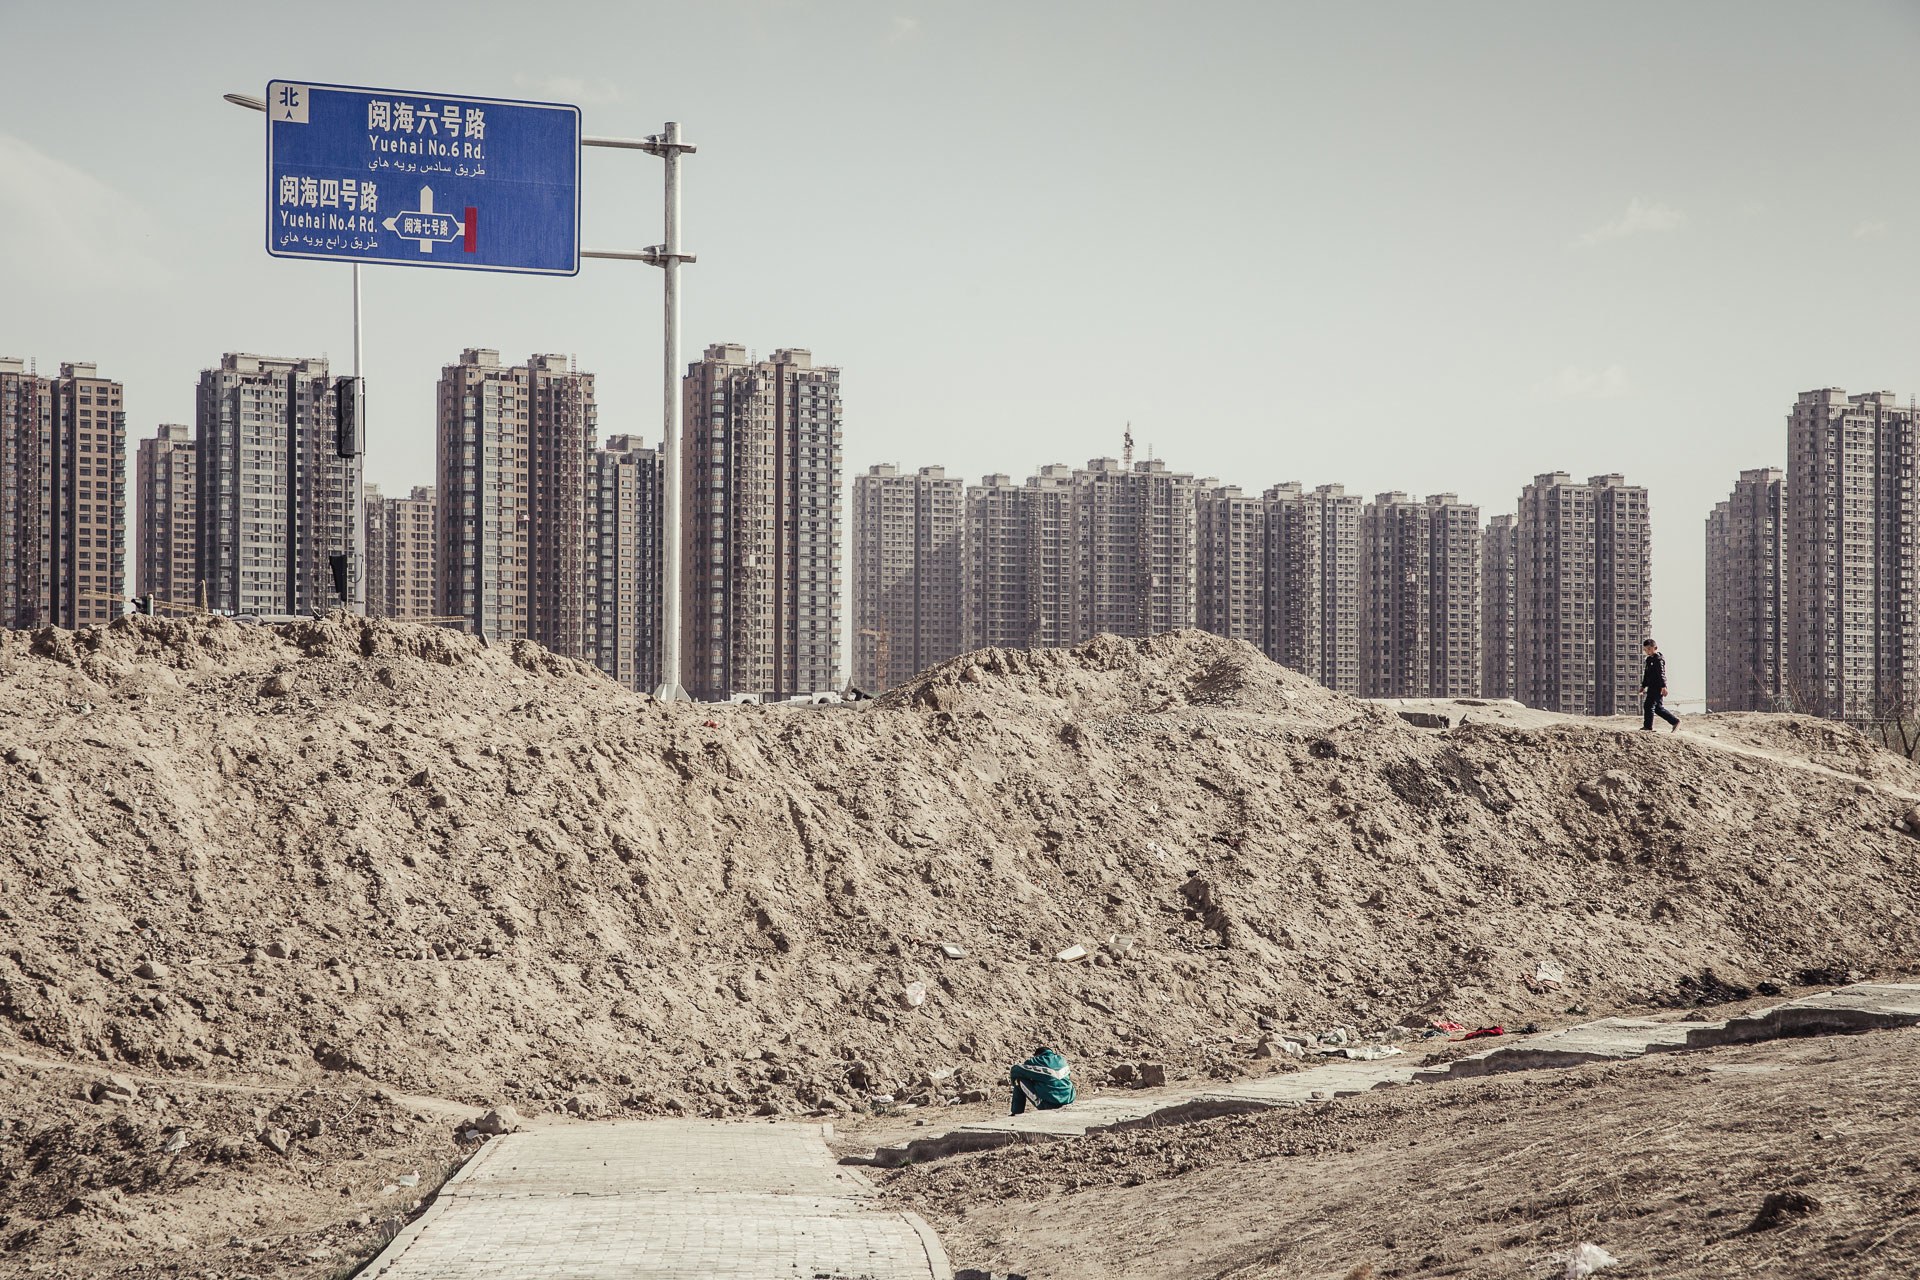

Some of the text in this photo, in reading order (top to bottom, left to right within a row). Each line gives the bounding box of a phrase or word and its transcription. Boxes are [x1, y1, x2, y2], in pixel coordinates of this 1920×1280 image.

[280, 87, 299, 107] 北
[368, 100, 485, 139] 阅海六号路
[369, 135, 484, 159] Yuehai No.6 Rd.
[420, 162, 451, 173] سادس
[455, 163, 485, 177] طريق
[280, 175, 378, 212] 阅海四号路
[281, 211, 377, 233] Yuehai No.4 Rd.
[404, 218, 448, 236] 阅海七号路
[326, 235, 347, 249] رابع
[351, 237, 378, 250] طريق
